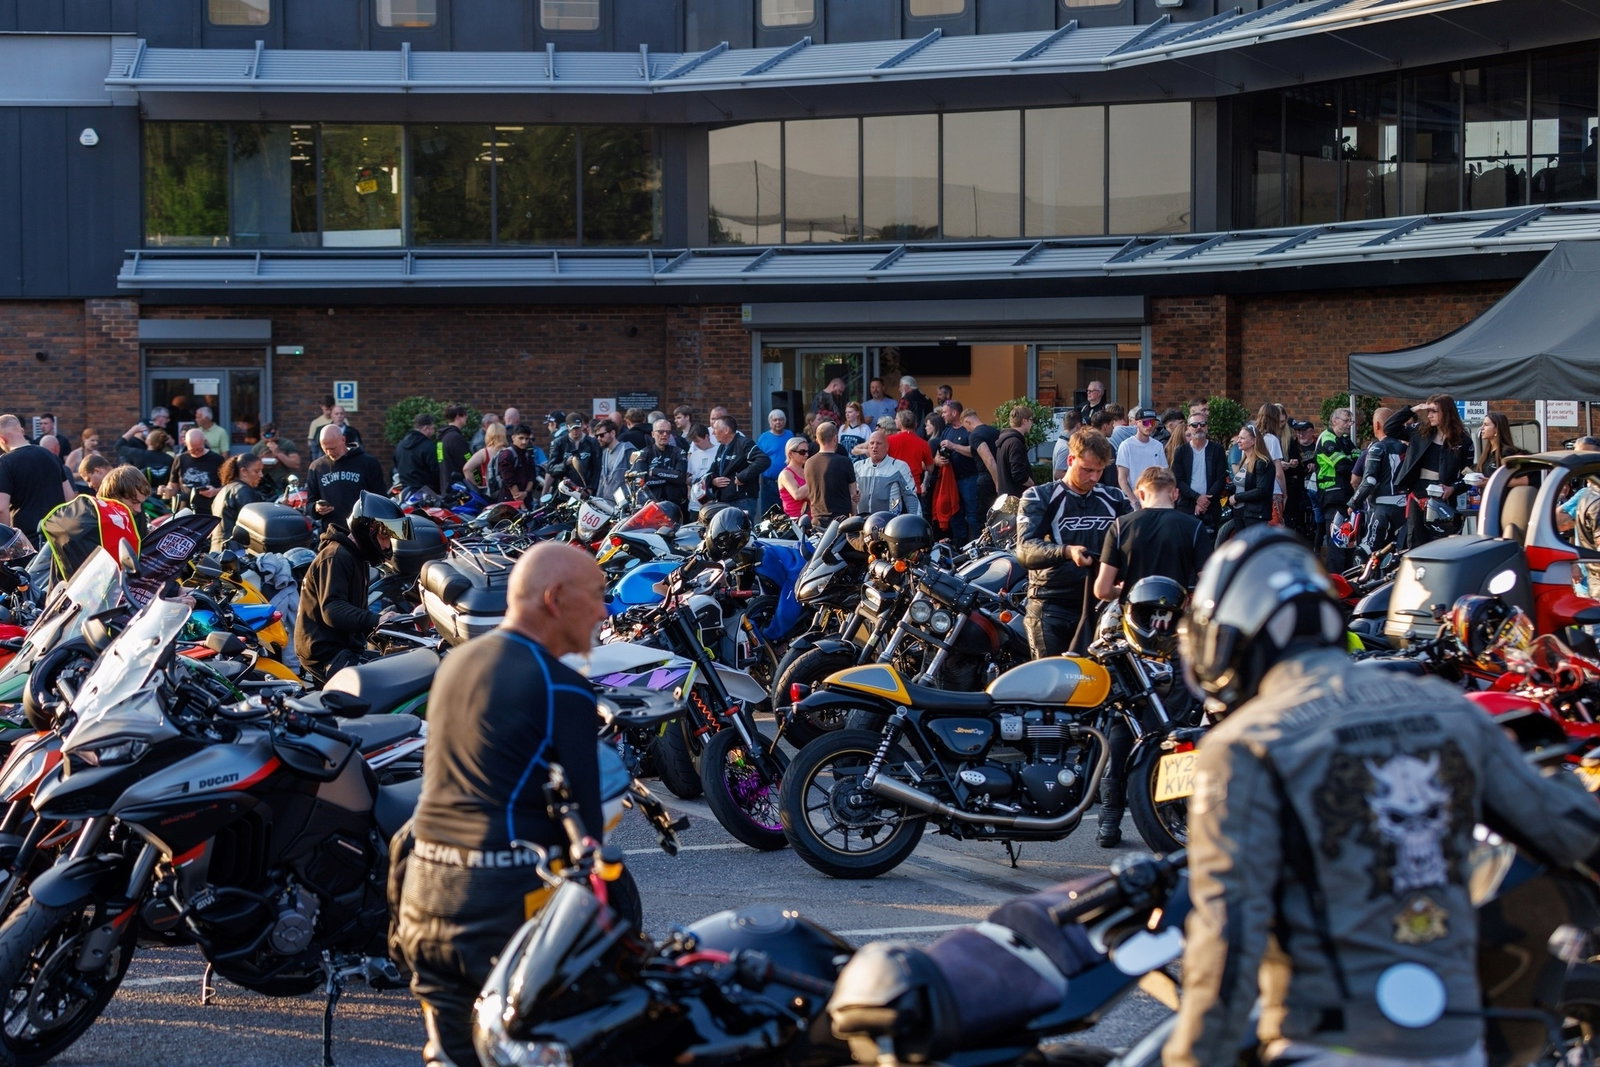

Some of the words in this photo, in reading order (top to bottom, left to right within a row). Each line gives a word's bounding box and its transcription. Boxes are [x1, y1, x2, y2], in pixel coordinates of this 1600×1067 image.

[340, 385, 351, 398] P
[341, 471, 360, 482] BOYS
[582, 511, 600, 527] 660
[1058, 516, 1116, 530] RST
[1165, 755, 1198, 776] YY2
[199, 773, 239, 789] DUCATI
[1164, 775, 1195, 795] KVK
[196, 896, 215, 910] GIVI
